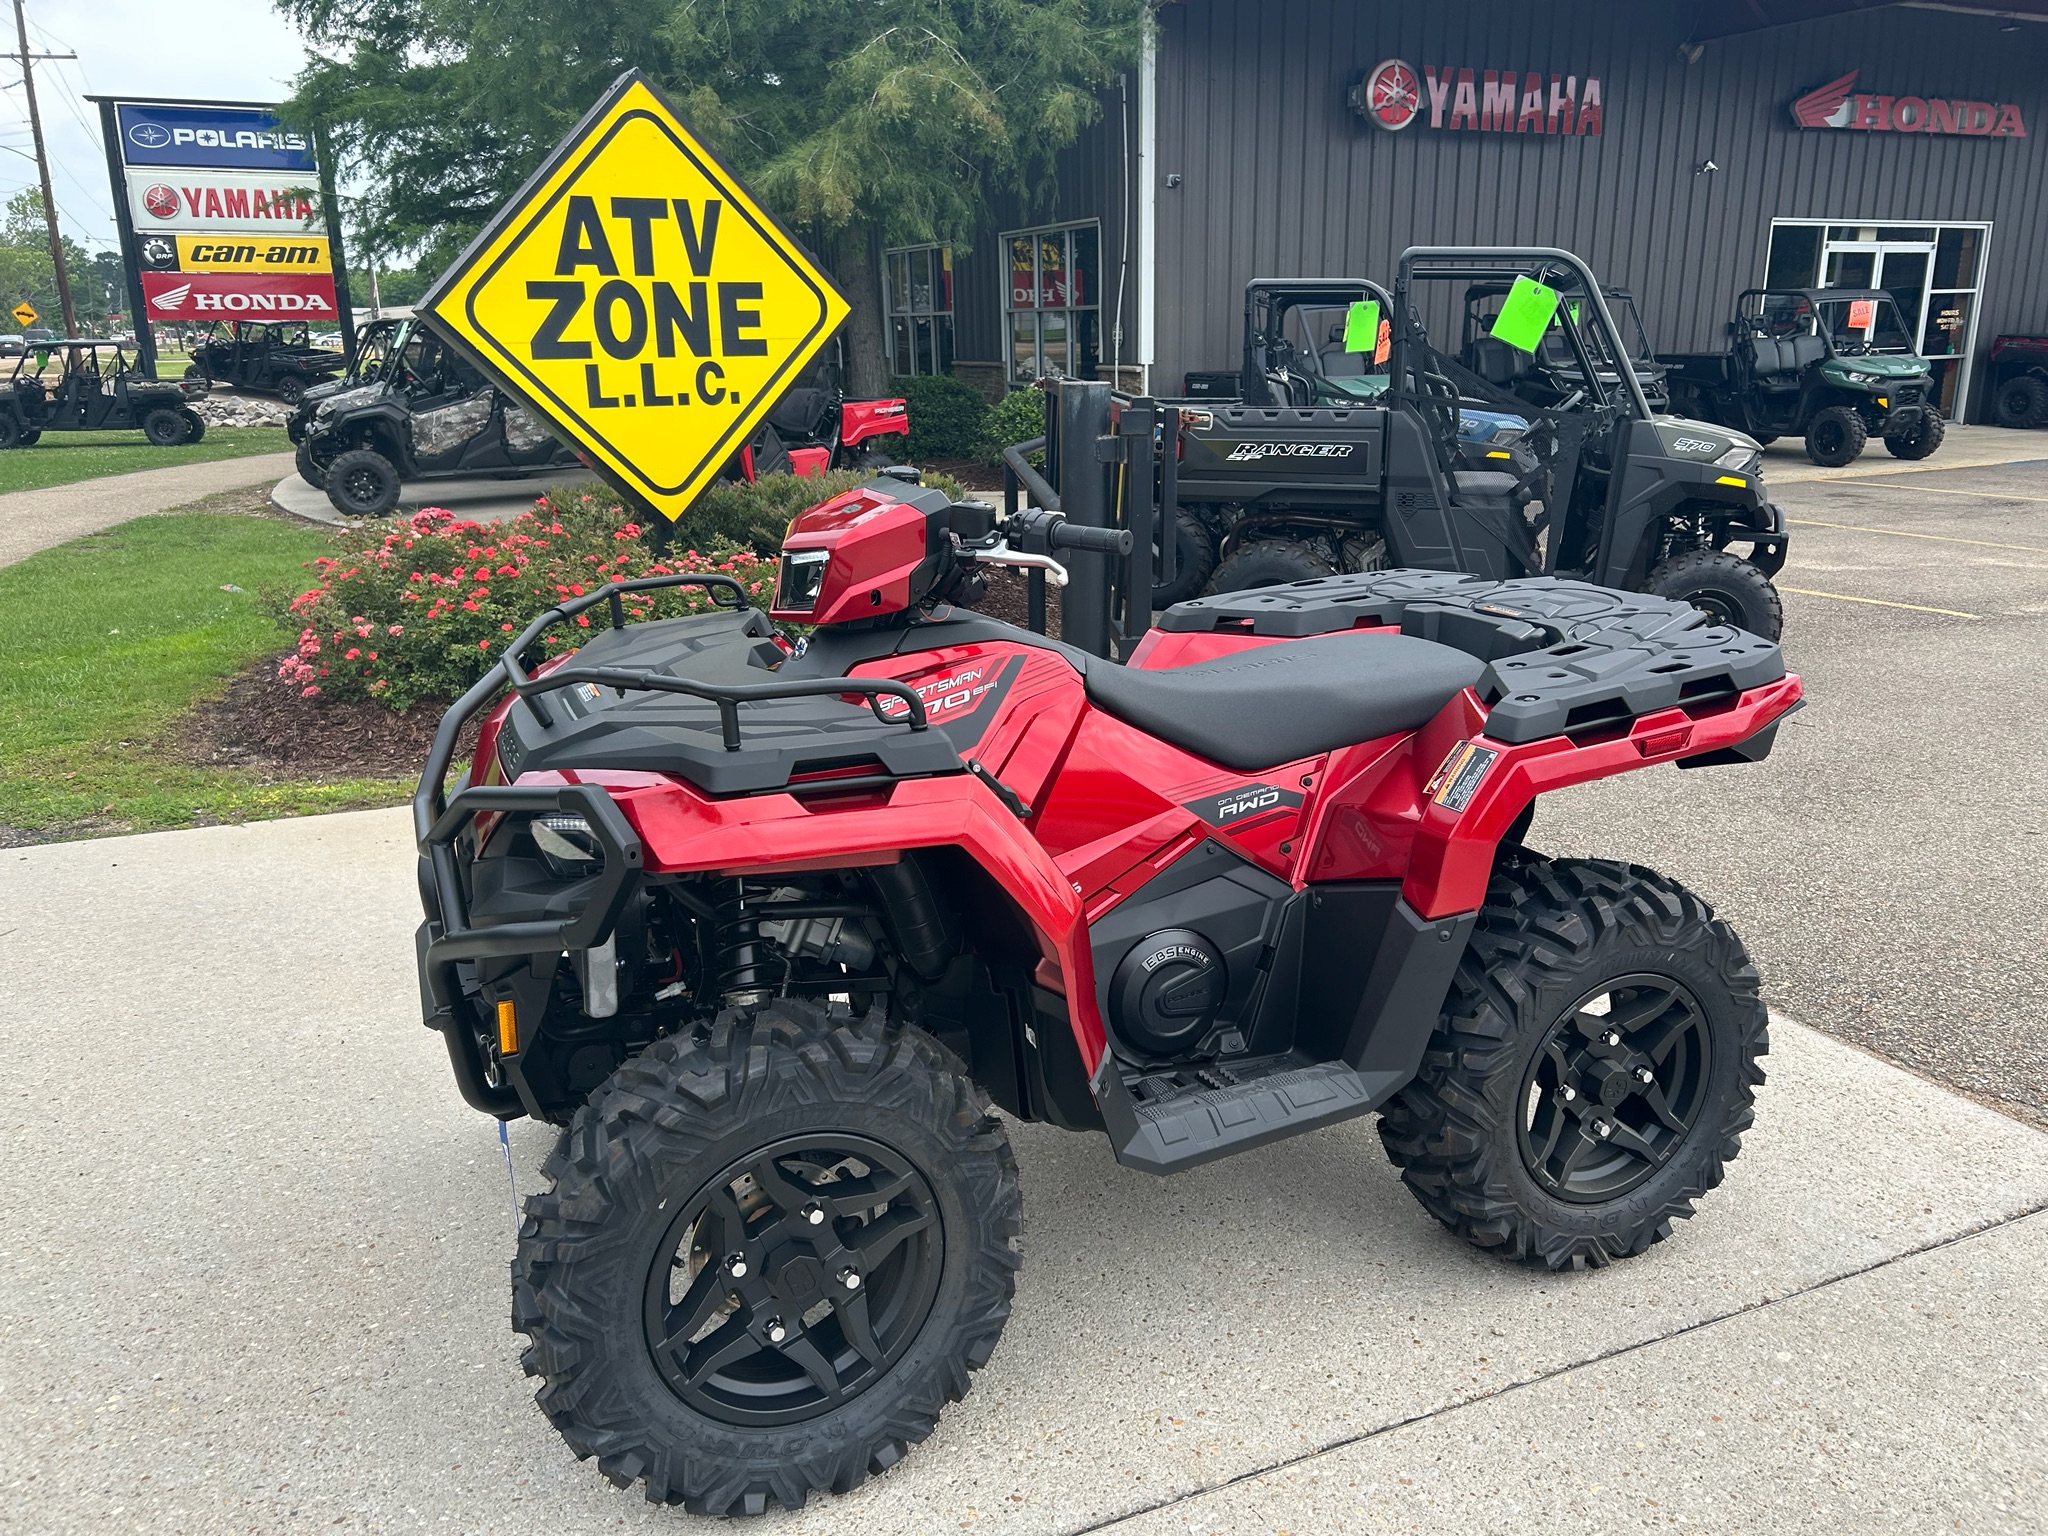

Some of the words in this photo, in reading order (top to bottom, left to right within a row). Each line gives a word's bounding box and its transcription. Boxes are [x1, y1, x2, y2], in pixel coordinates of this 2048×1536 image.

[1424, 64, 1601, 136] YAMAHA
[1850, 93, 2028, 138] HONDA
[172, 127, 308, 151] POLARIS
[180, 186, 315, 220] YAMAHA
[554, 195, 722, 277] ATV
[190, 244, 320, 264] can-am
[193, 293, 332, 311] HONDA
[1852, 306, 1870, 318] SALE
[525, 279, 768, 361] ZONE
[584, 360, 741, 409] L.L.C.
[1232, 443, 1354, 458] RANGER
[1673, 437, 1717, 453] 570
[879, 667, 983, 712] SPRTSMAN
[972, 681, 998, 696] EFI
[1218, 797, 1233, 806] ON
[1235, 784, 1280, 800] DEMAND
[1219, 791, 1280, 819] AWD
[1145, 947, 1176, 969] EBS
[1177, 946, 1210, 965] ENGINE
